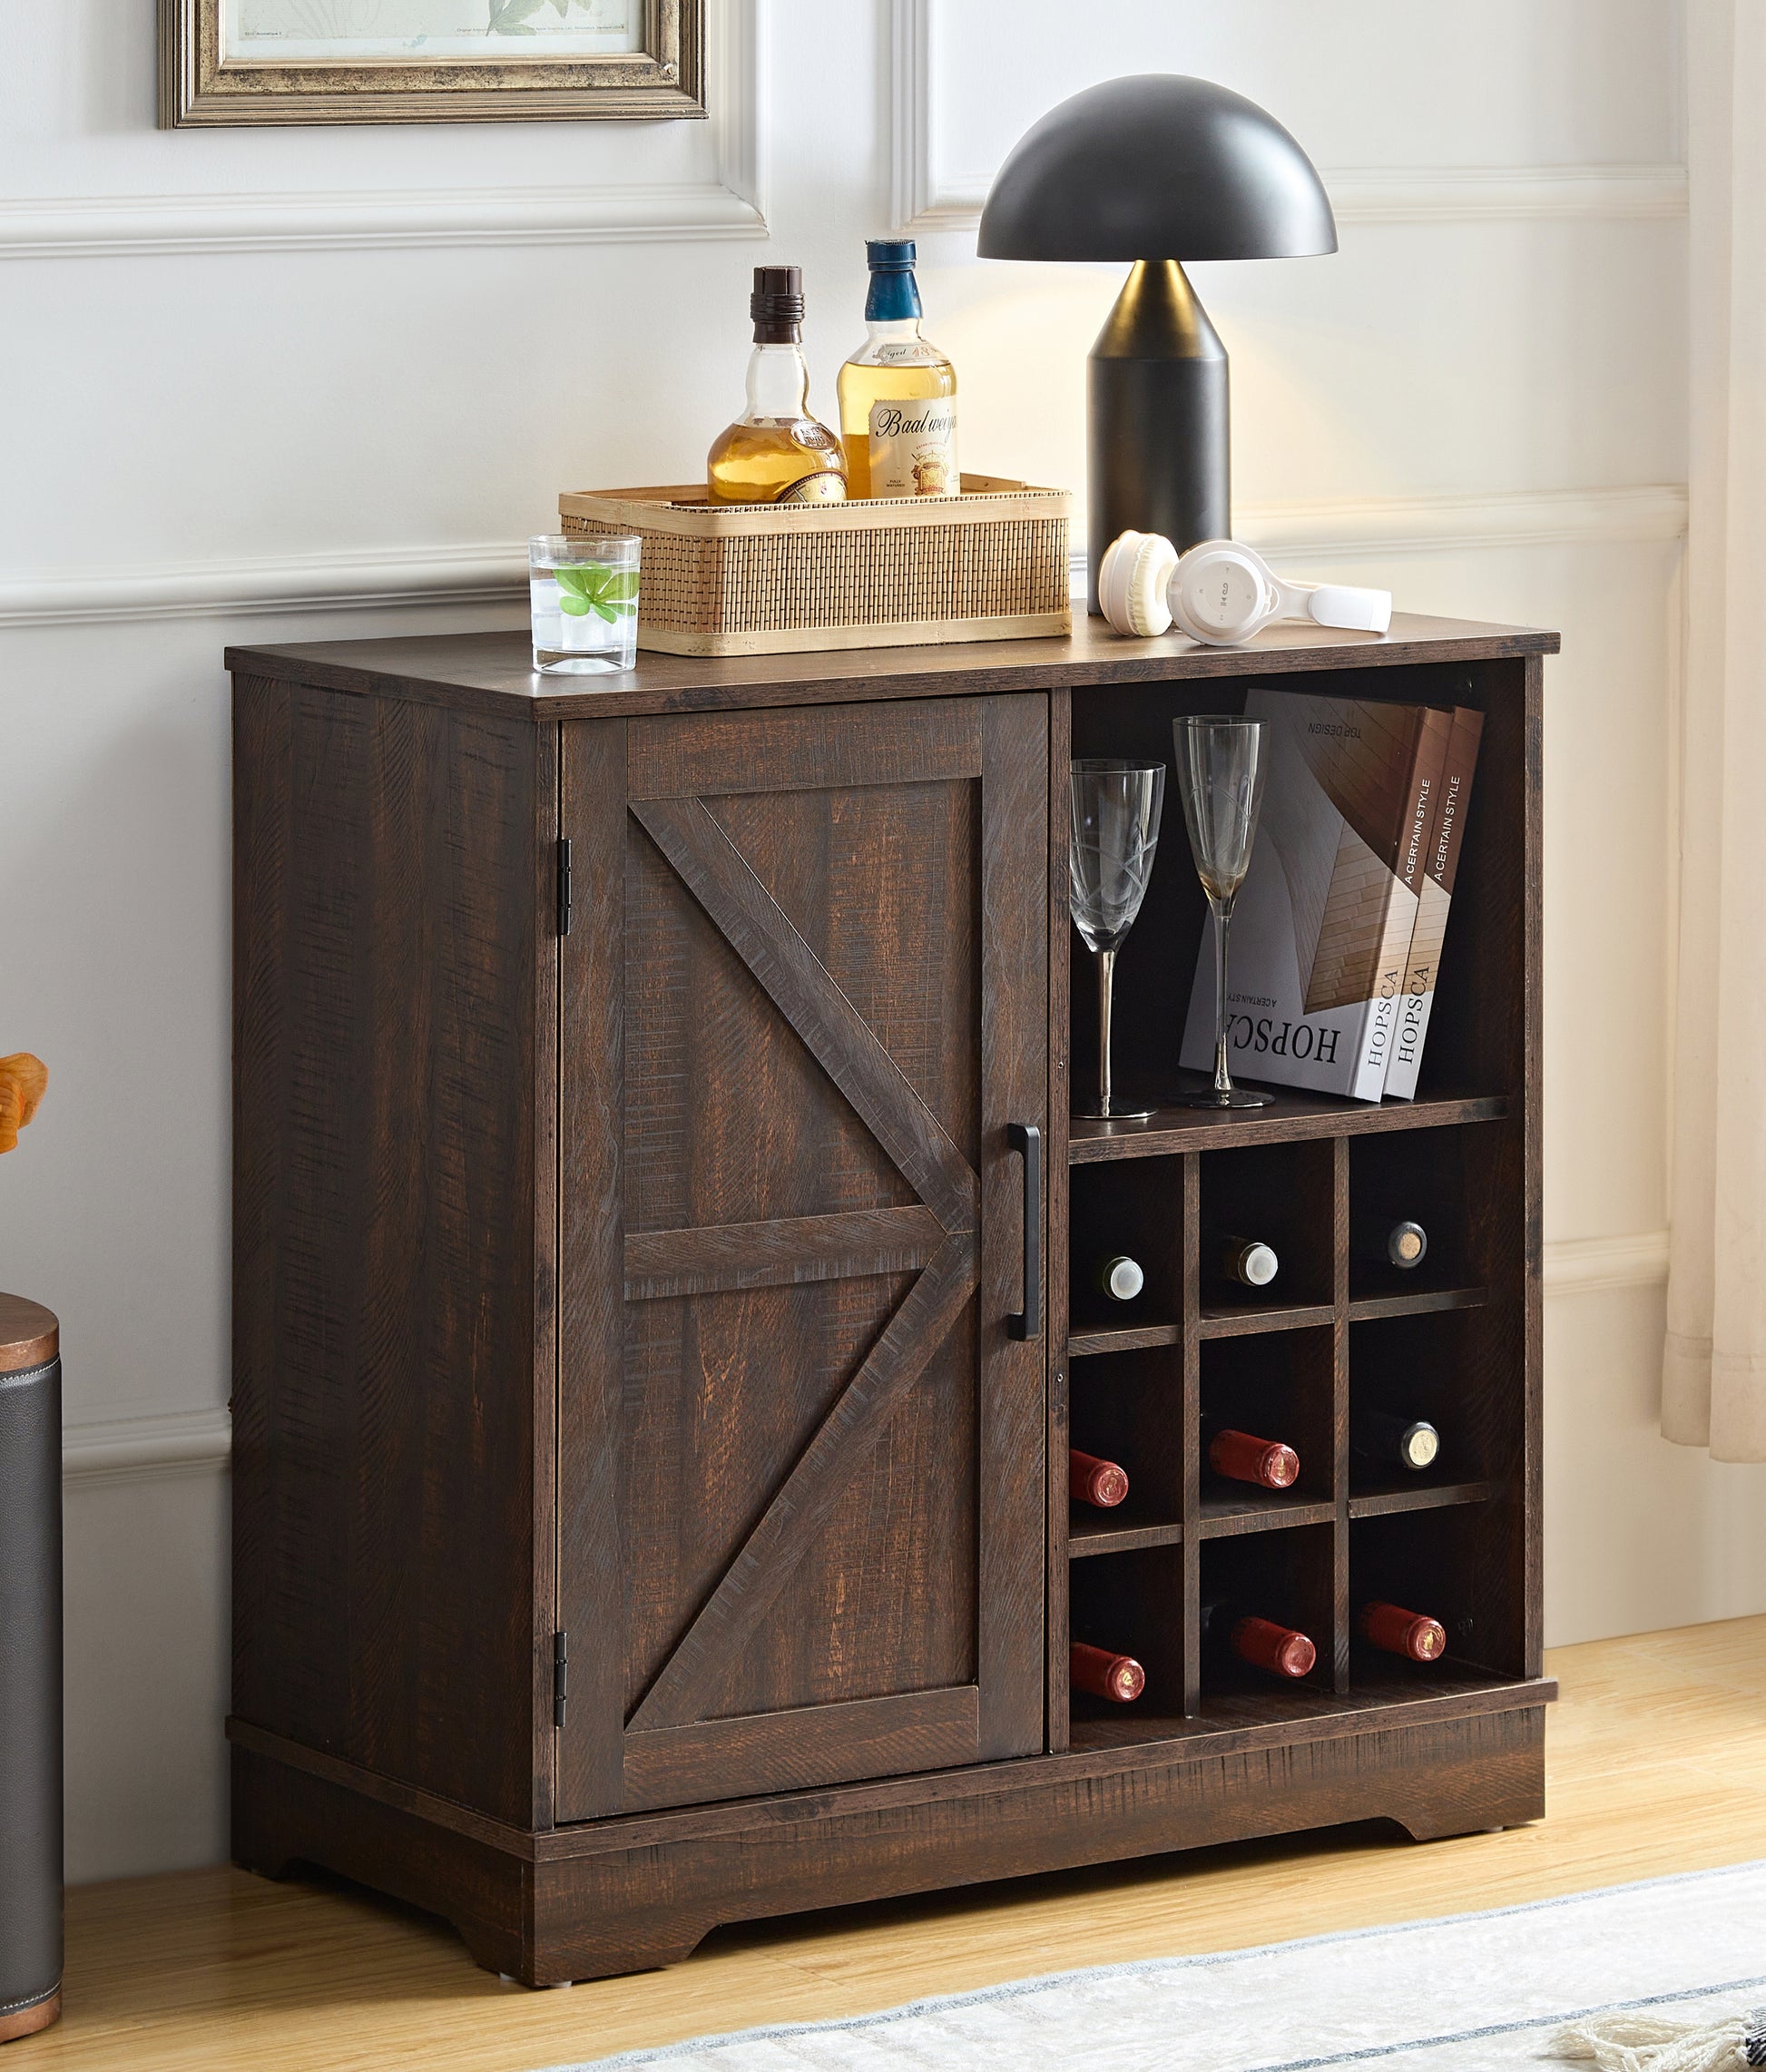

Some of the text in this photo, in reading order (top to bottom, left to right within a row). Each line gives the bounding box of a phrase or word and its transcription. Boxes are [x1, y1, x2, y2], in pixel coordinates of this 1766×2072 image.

[875, 408, 930, 437] Baal
[1308, 722, 1343, 737] DESIGN
[1404, 779, 1431, 885] A CERTAIN STYLE
[1434, 776, 1460, 881] A CERTAIN STYLE
[1226, 993, 1241, 1003] STY
[1241, 995, 1271, 1007] CERTAIN
[1368, 969, 1398, 1068] HOPSCA
[1398, 966, 1430, 1065] HOPSCA
